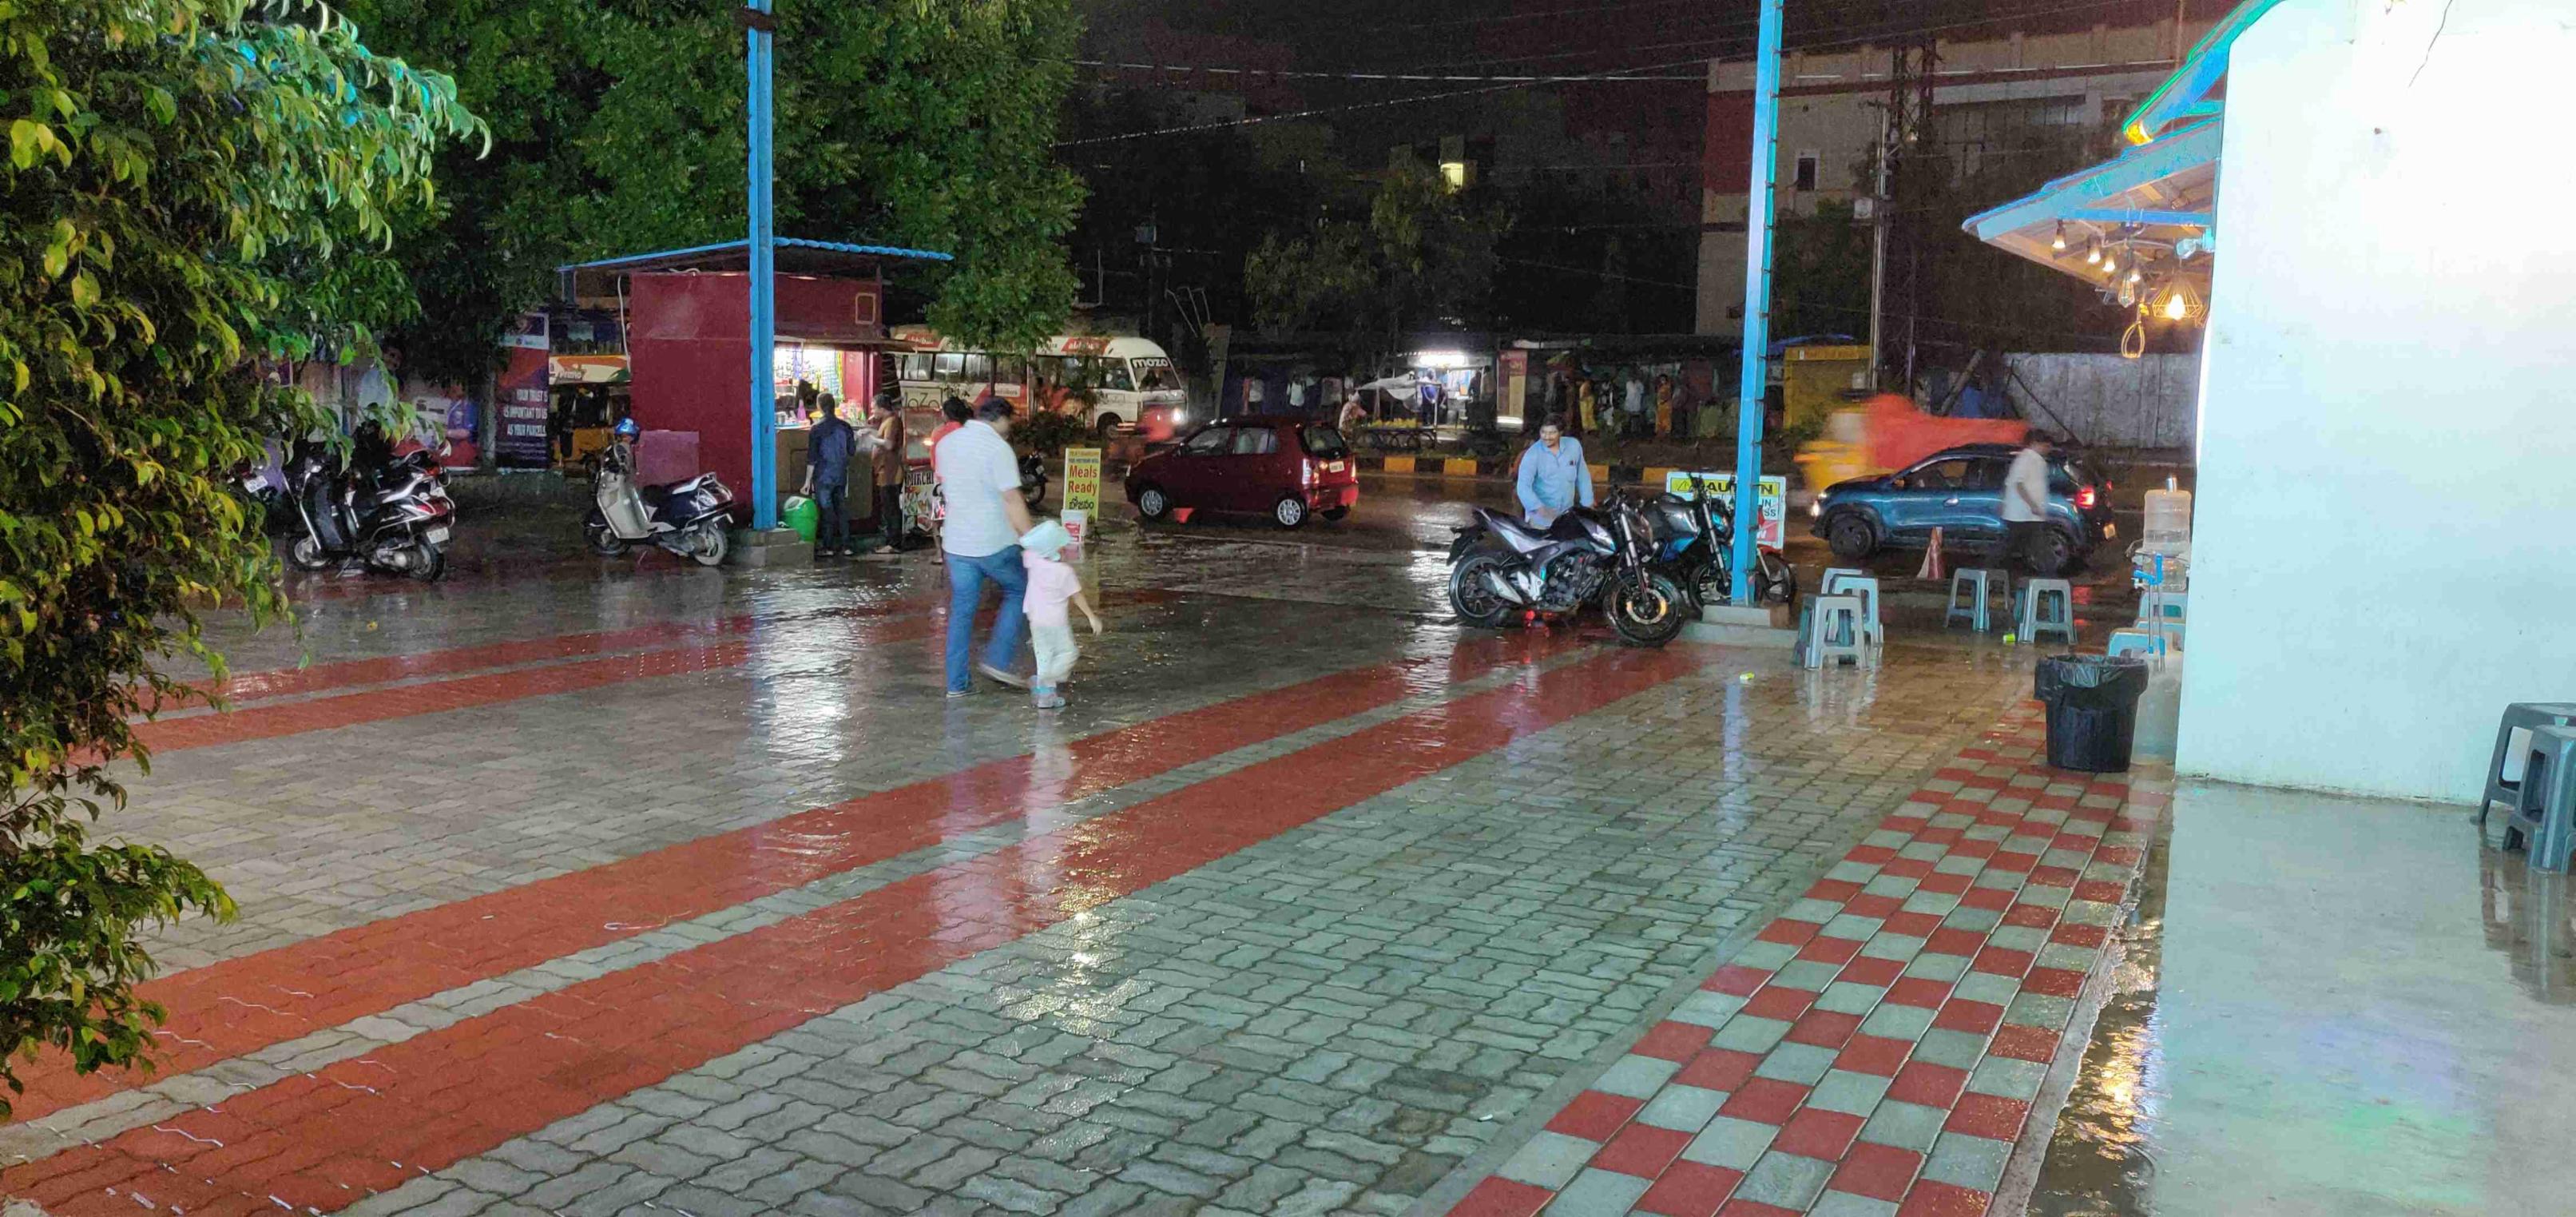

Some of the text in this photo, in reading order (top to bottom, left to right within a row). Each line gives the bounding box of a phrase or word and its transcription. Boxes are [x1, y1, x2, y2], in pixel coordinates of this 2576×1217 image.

[1132, 358, 1169, 368] mozo
[1070, 465, 1097, 478] Meals
[1068, 480, 1097, 496] Ready
